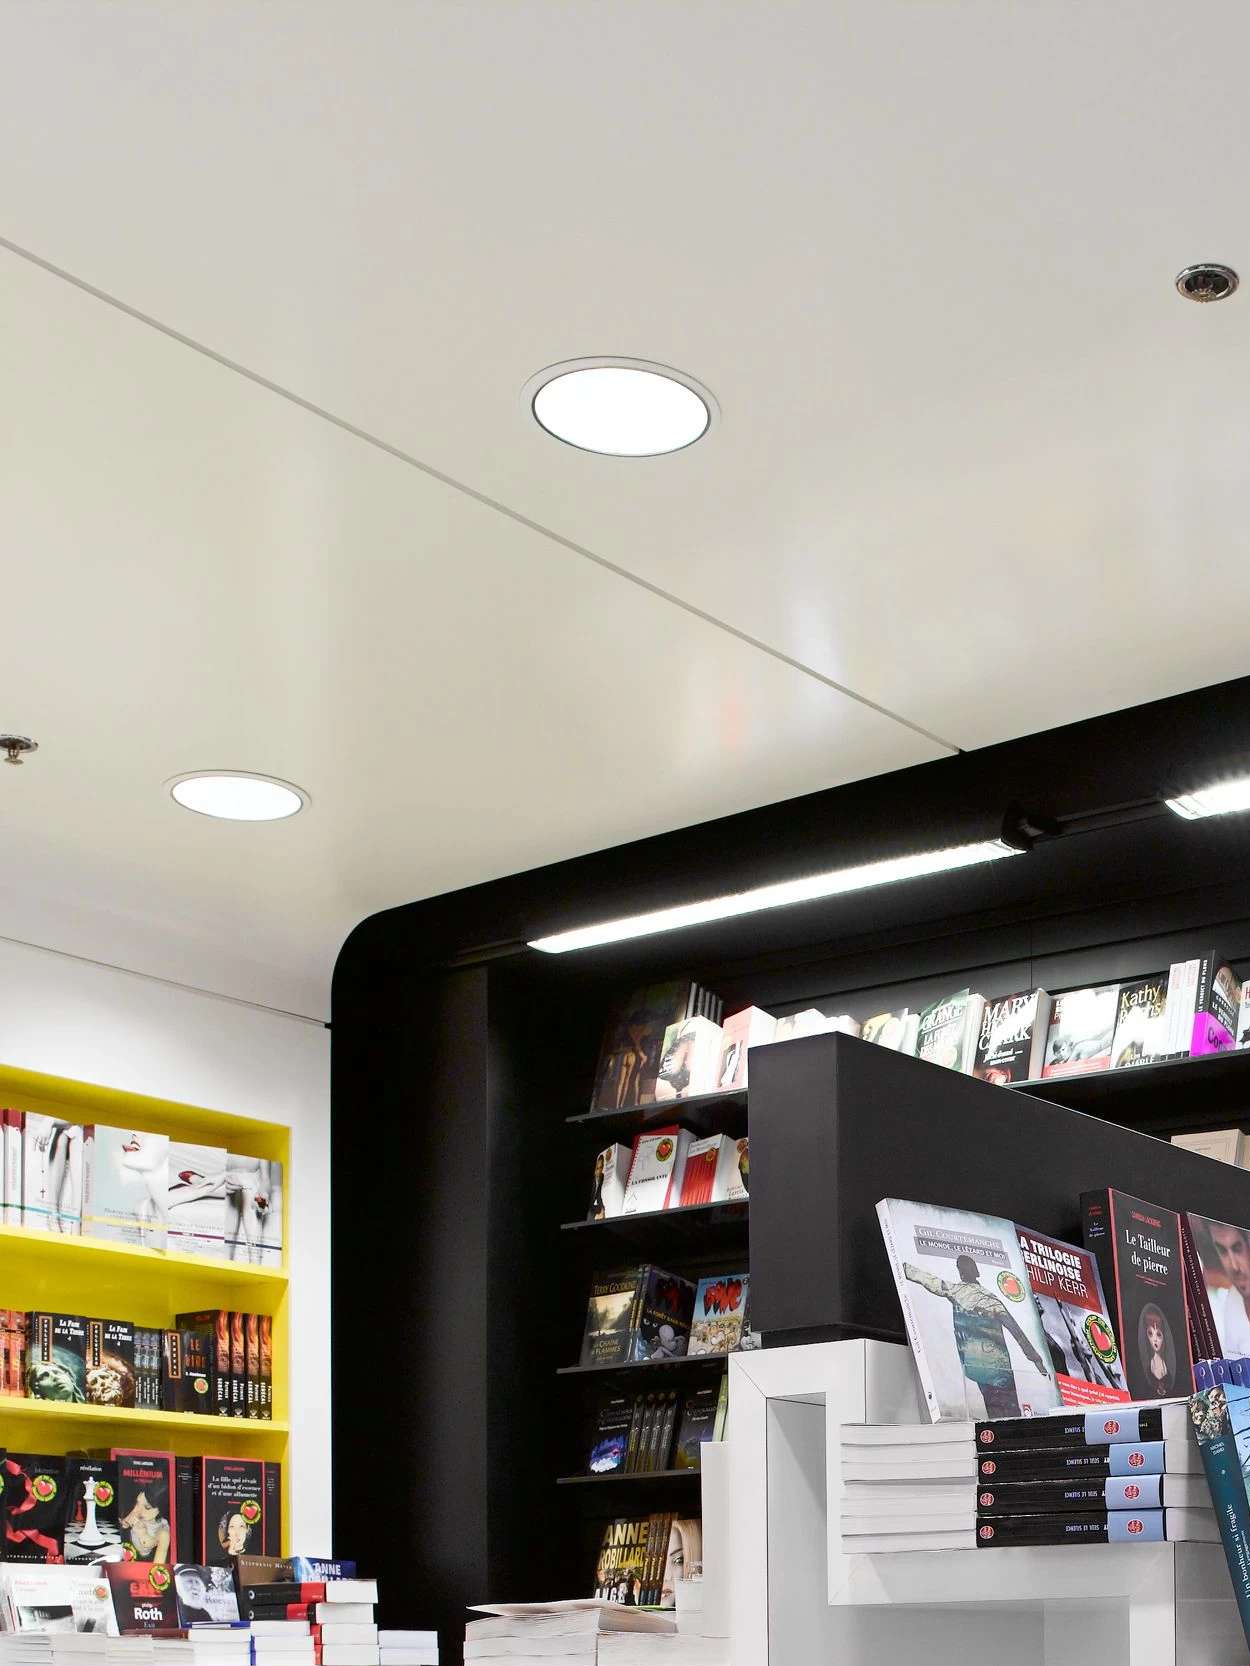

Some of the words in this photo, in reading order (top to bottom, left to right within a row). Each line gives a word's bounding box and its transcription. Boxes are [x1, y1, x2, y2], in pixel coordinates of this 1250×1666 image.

[1121, 984, 1161, 1008] Kathy
[1030, 1239, 1082, 1269] TRILOGIE
[1126, 1229, 1137, 1246] Le
[1138, 1233, 1170, 1258] Tailleur
[1131, 1251, 1141, 1267] de
[1142, 1255, 1169, 1276] pierre
[1059, 1277, 1089, 1298] KERR
[1226, 1504, 1237, 1532] fragile
[602, 1522, 649, 1546] ANNE
[314, 1563, 342, 1575] ANNE
[1237, 1542, 1249, 1582] bonheur
[134, 1608, 163, 1621] Roth
